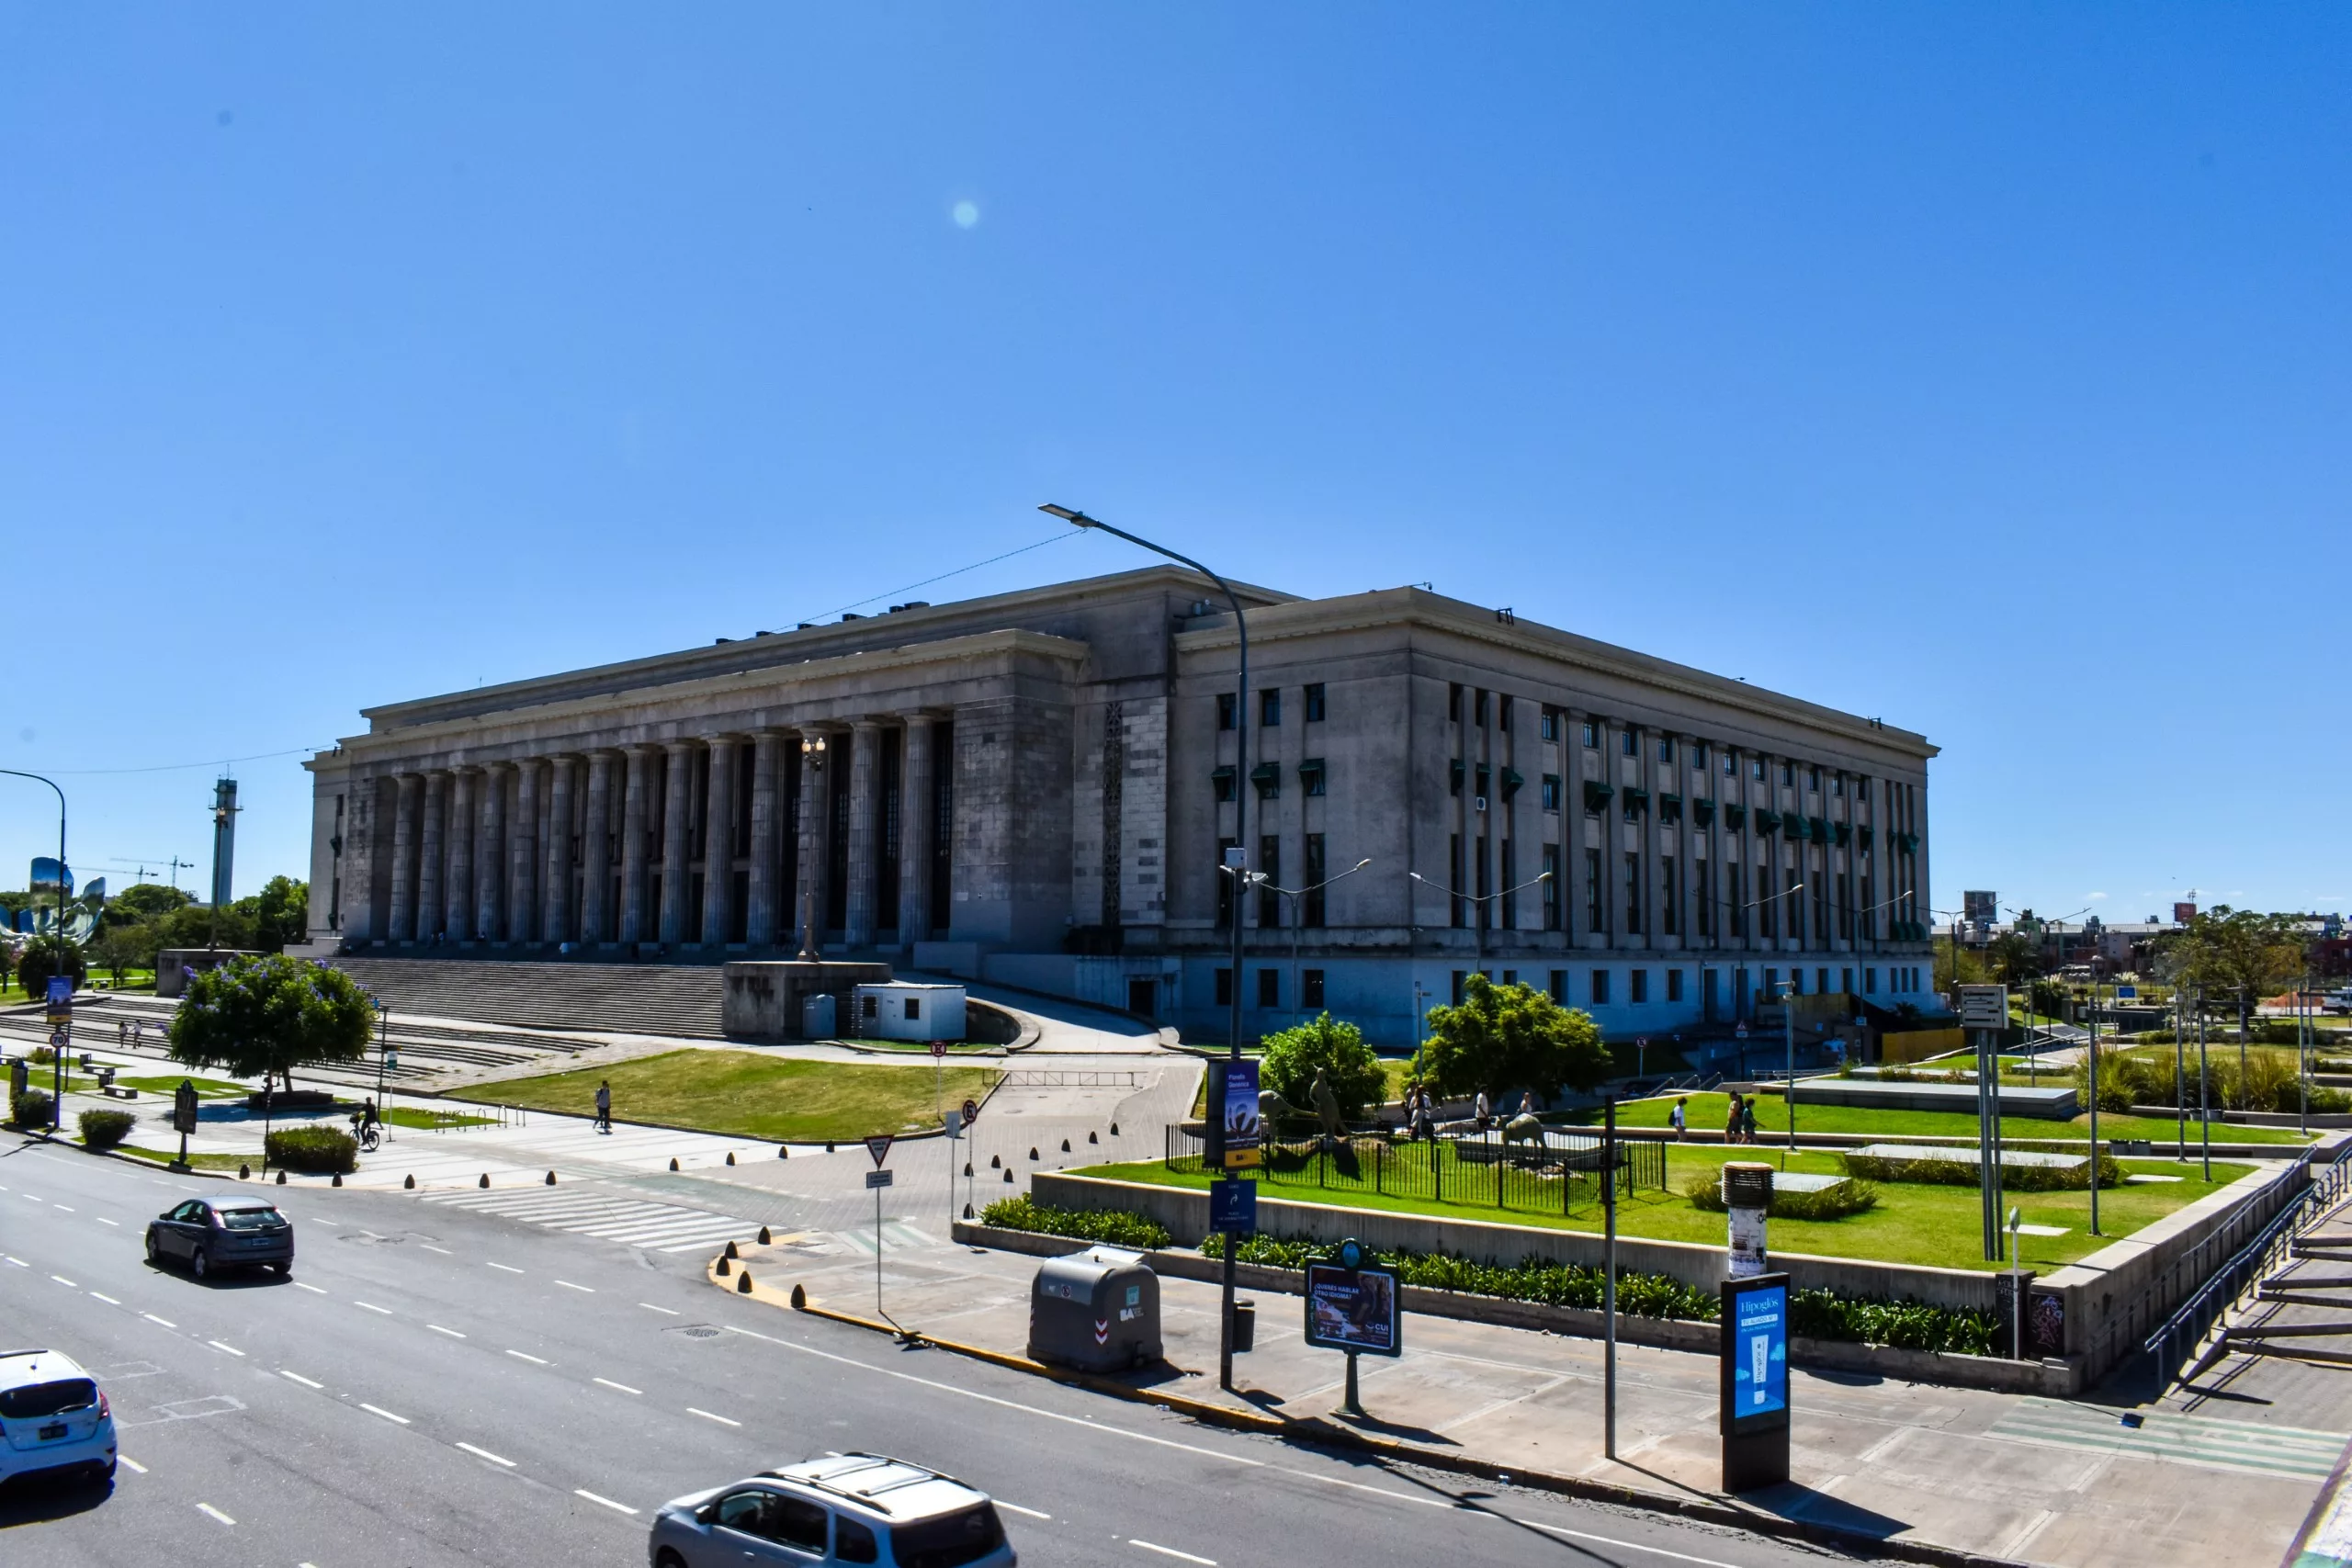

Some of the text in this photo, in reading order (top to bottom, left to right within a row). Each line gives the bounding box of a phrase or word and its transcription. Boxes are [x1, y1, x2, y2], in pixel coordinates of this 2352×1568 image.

[1338, 1286, 1360, 1294] HABLAR
[1741, 1296, 1779, 1314] Hipoglós
[1375, 1323, 1388, 1331] CUI
